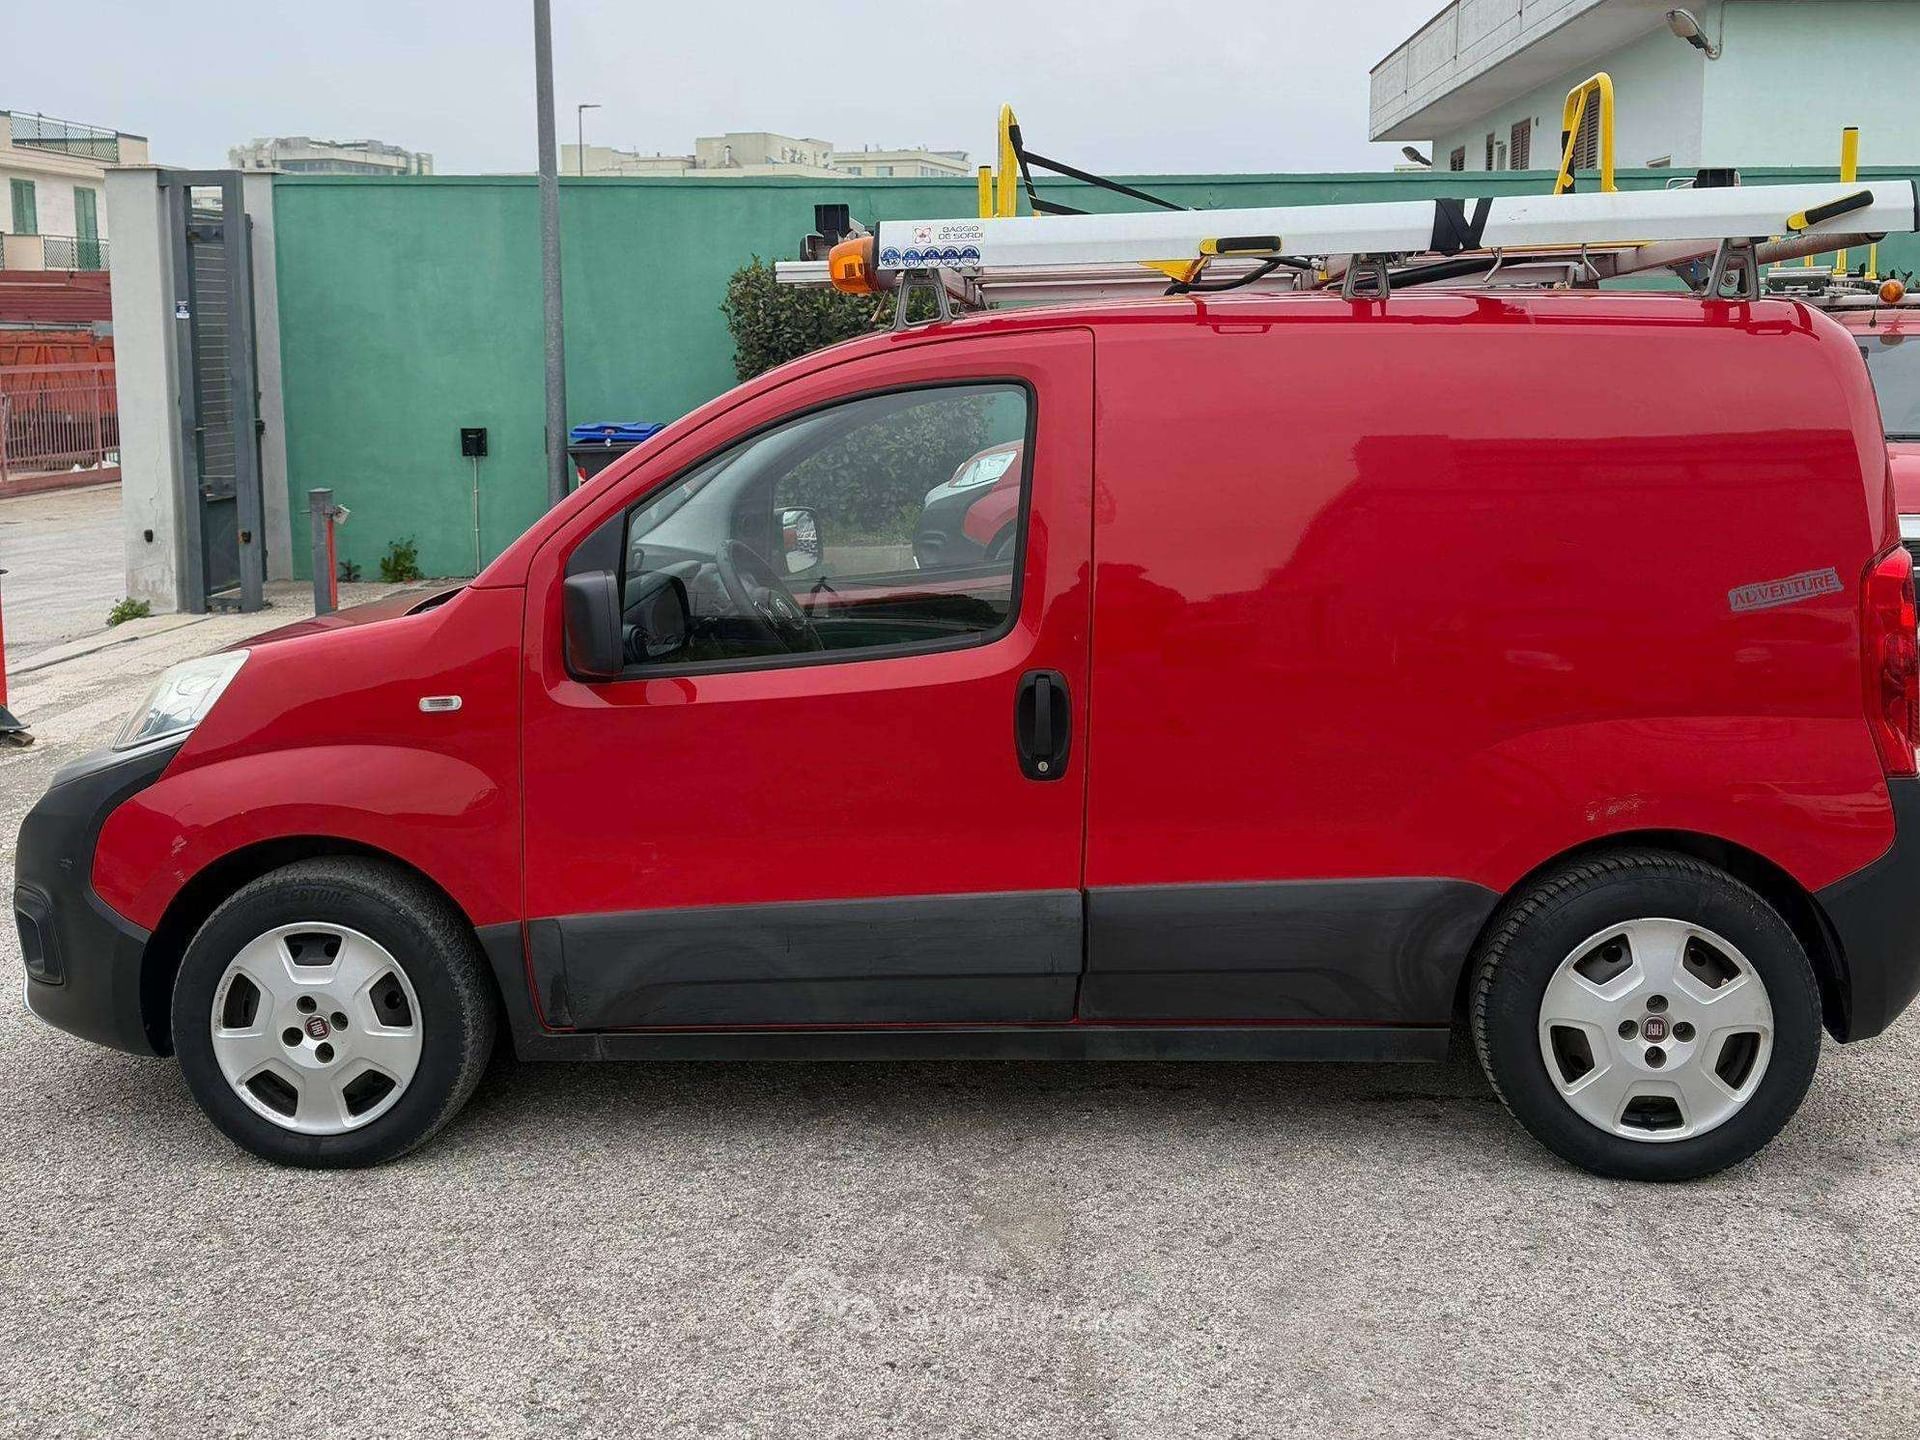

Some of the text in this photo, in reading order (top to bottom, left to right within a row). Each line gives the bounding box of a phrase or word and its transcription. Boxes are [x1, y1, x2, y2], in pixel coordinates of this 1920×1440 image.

[1733, 573, 1836, 605] ADVENTURE
[309, 1020, 326, 1036] FIAT
[1647, 1023, 1663, 1036] FIAT
